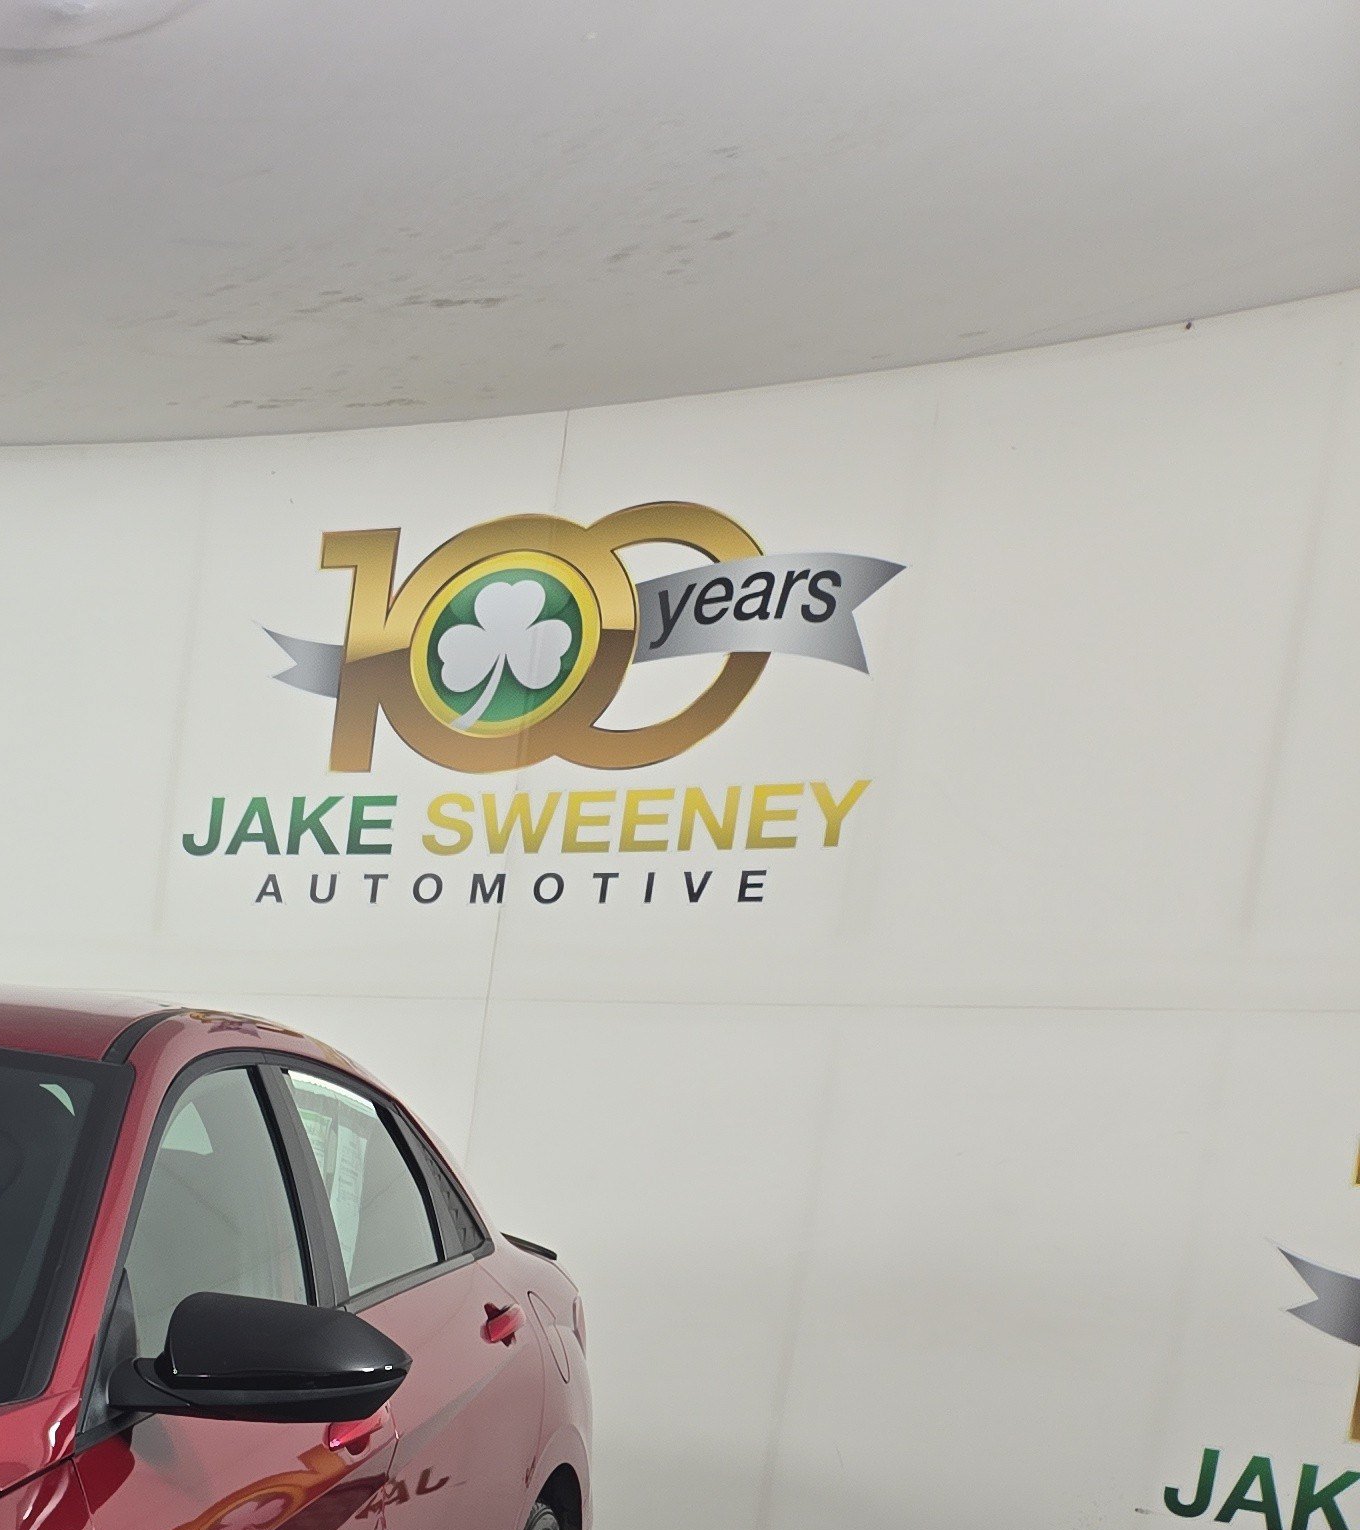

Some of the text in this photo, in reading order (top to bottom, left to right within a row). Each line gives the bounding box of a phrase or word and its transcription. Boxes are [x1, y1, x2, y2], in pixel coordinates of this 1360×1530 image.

[320, 501, 772, 774] 100
[649, 567, 842, 650] years
[182, 779, 872, 857] JAKE SWEENEY
[255, 869, 768, 905] AUTOMOTIVE
